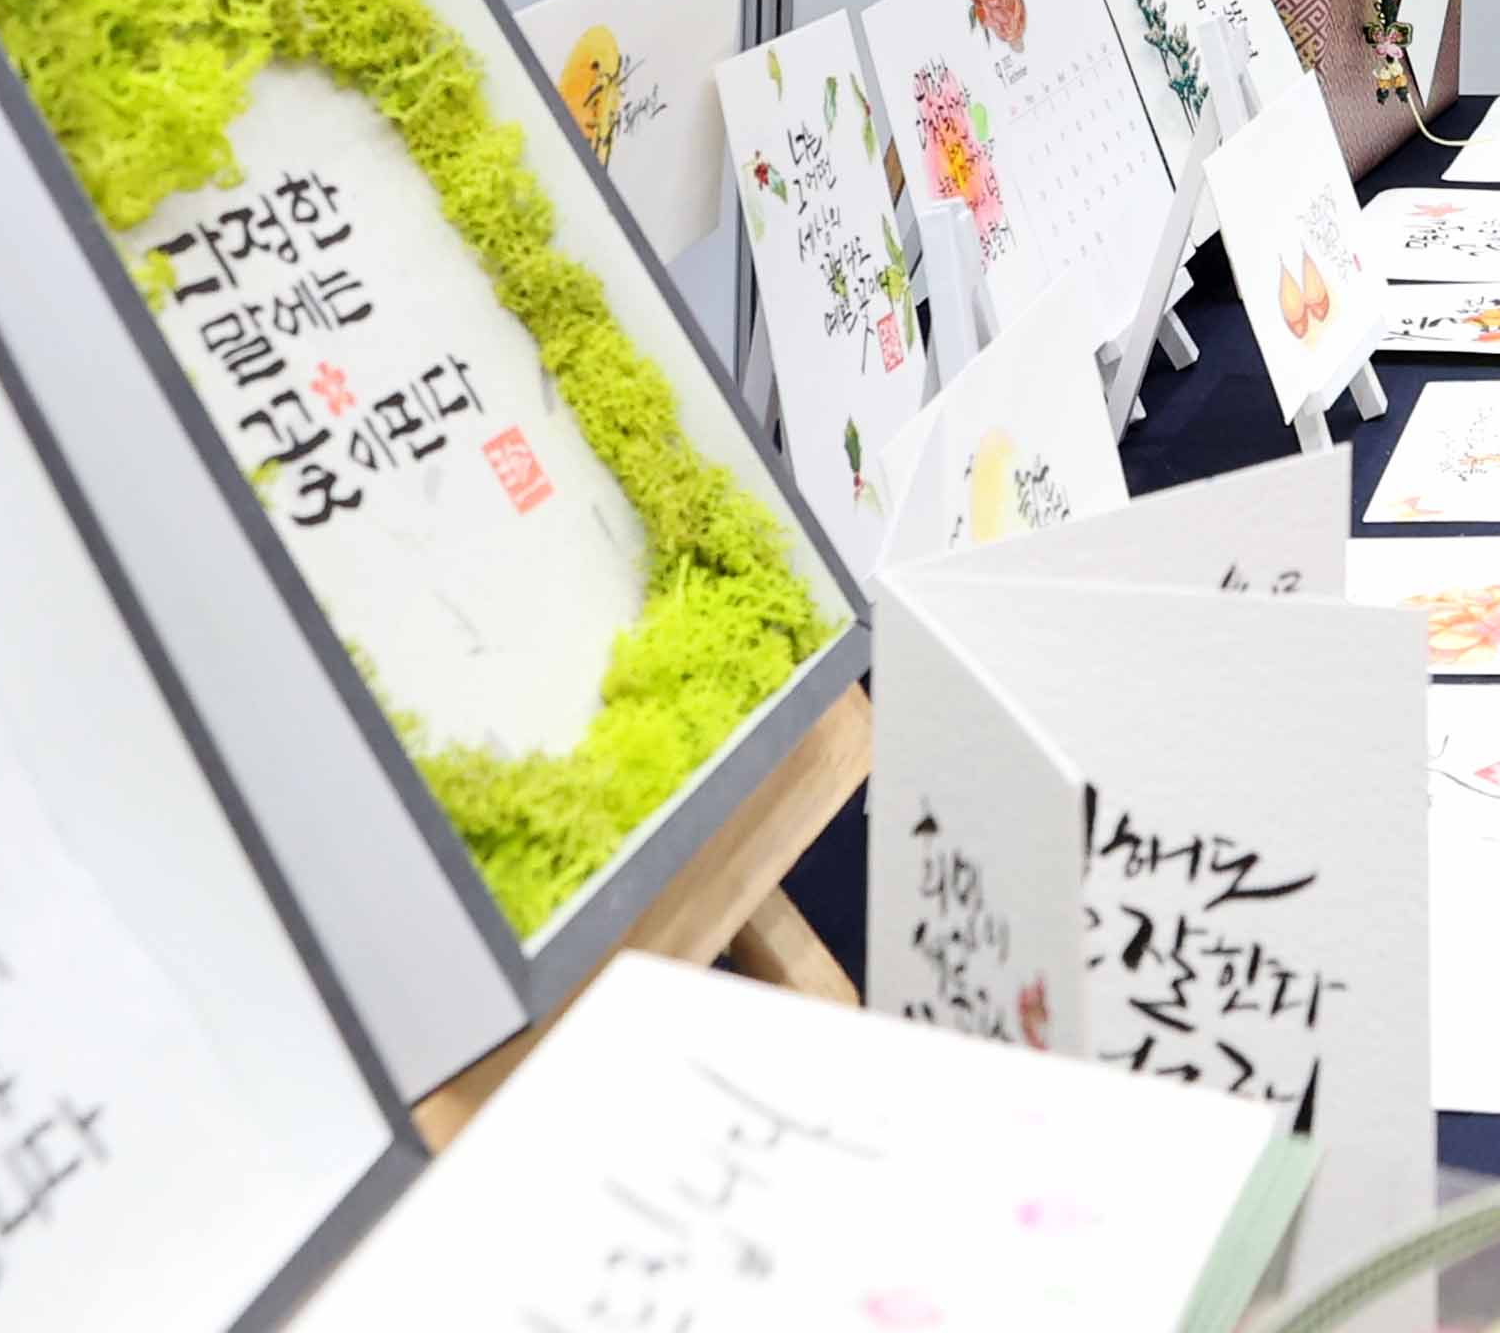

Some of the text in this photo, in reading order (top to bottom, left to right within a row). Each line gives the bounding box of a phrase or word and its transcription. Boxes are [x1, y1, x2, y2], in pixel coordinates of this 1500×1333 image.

[152, 166, 354, 305] 다정한
[199, 267, 375, 394] 말에는
[241, 386, 400, 527] 꽃이
[373, 353, 486, 465] 핀다
